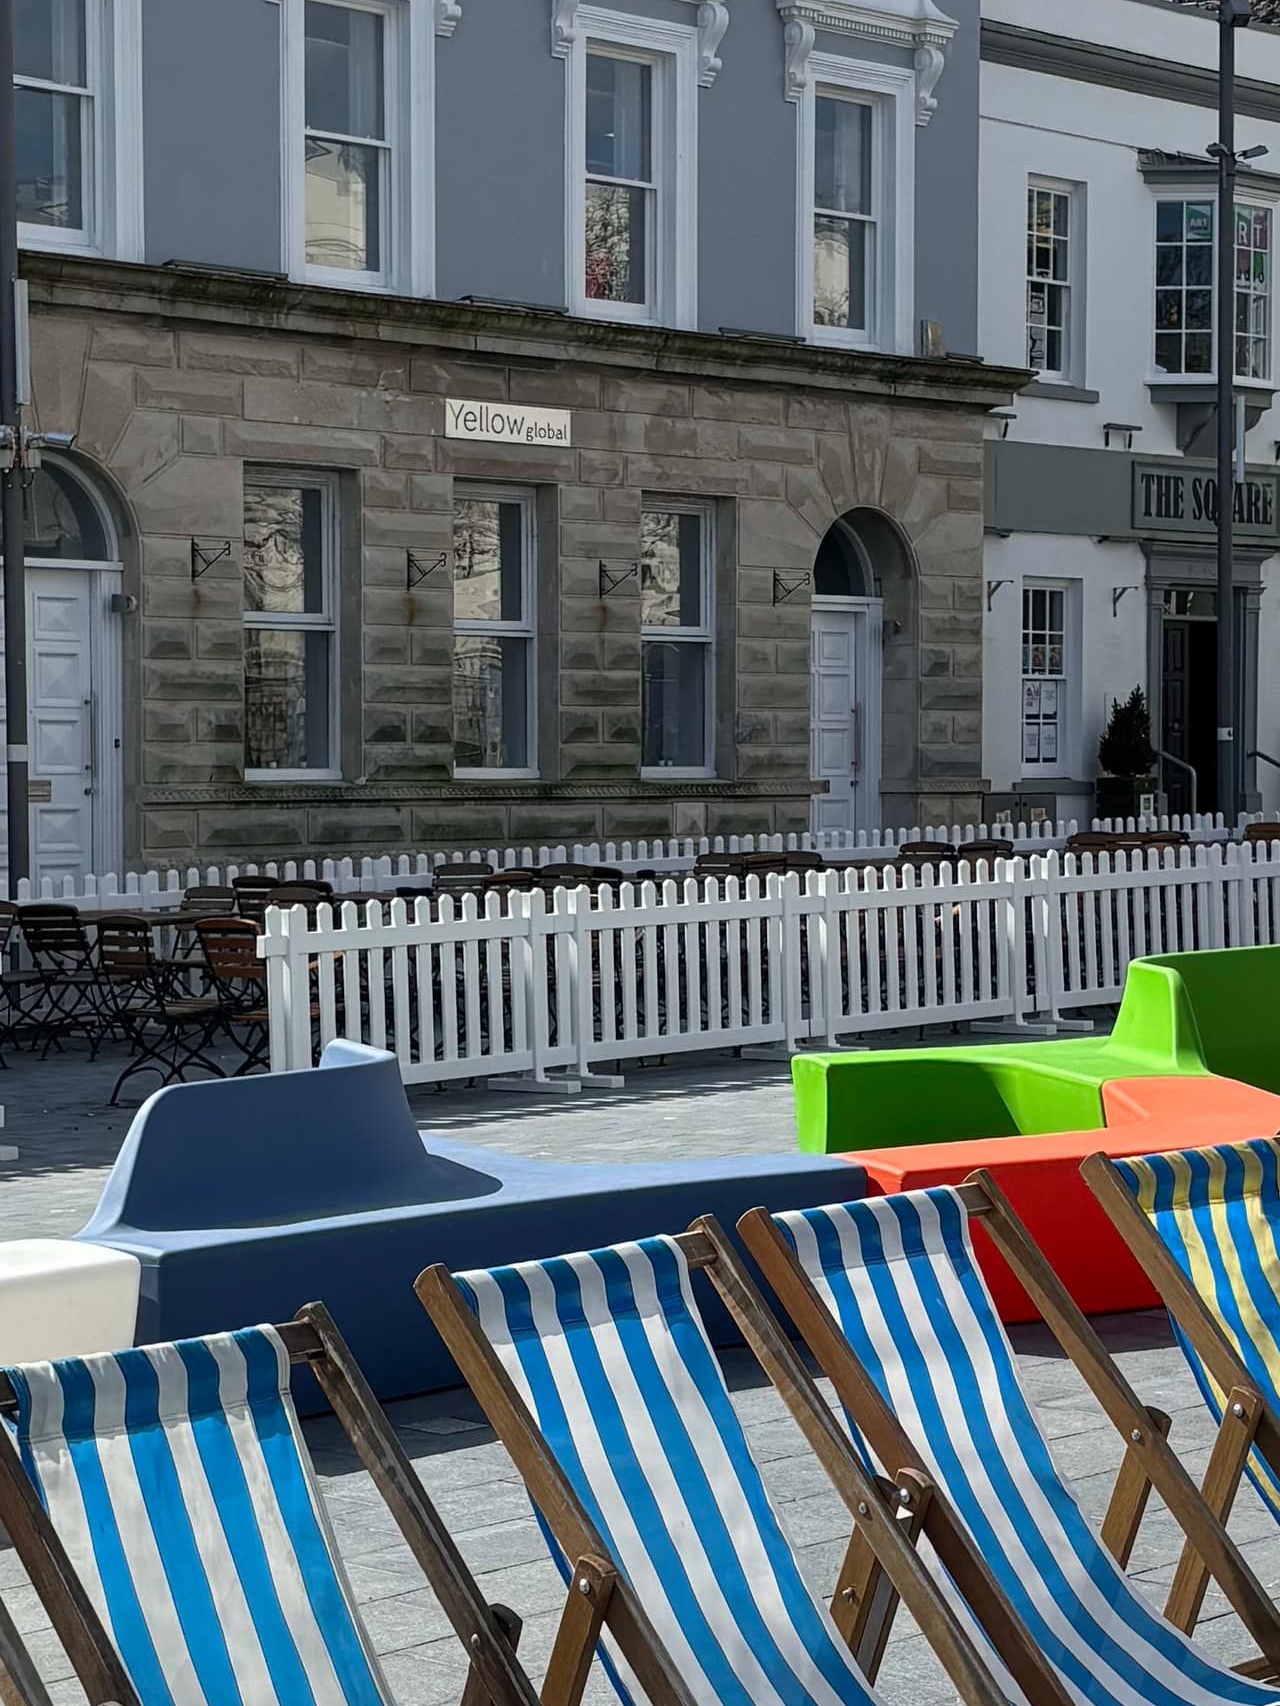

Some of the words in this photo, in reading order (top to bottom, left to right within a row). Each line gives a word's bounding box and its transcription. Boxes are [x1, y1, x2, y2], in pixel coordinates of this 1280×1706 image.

[448, 402, 525, 436] Yellow
[526, 422, 568, 442] global
[1141, 473, 1185, 519] THE
[1192, 477, 1273, 527] SQARE
